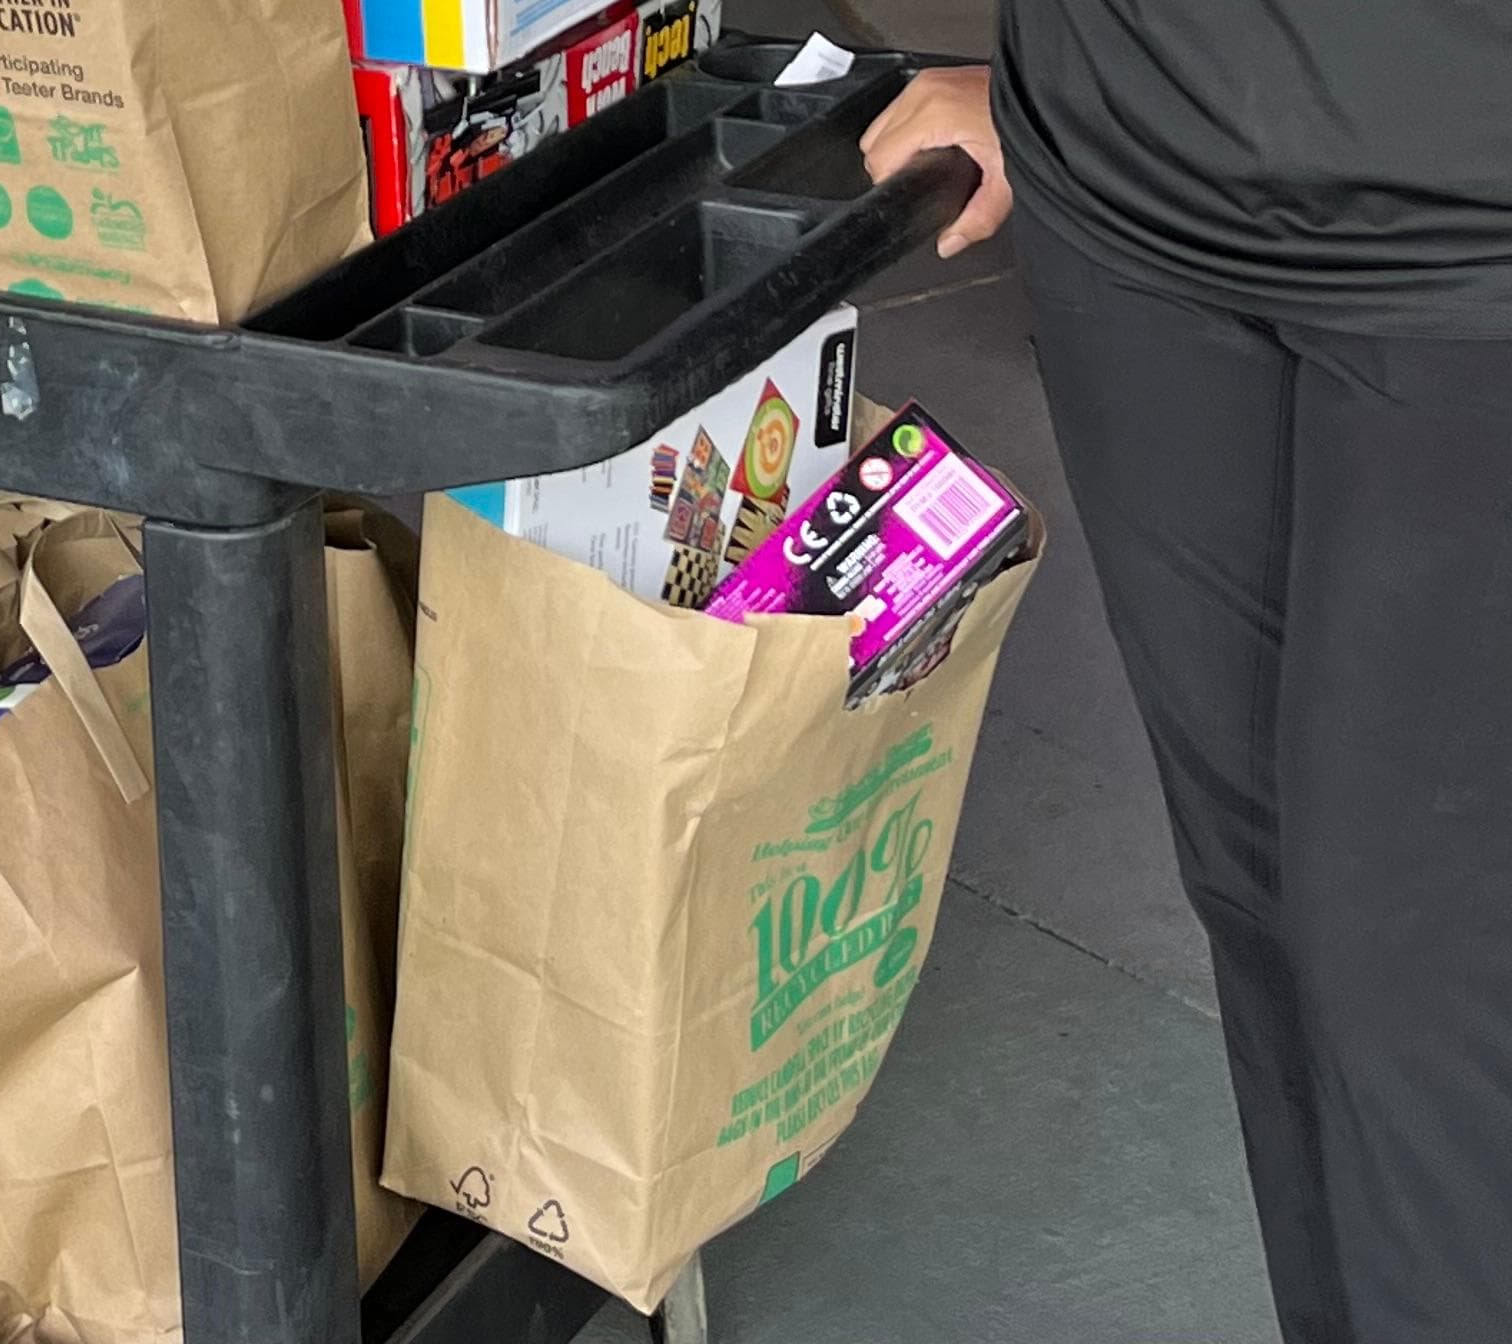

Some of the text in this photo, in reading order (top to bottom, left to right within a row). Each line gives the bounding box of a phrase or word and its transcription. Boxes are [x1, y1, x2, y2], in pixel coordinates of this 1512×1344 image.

[1, 76, 56, 99] Teeter
[62, 81, 125, 109] Brands
[748, 787, 934, 1012] 100%
